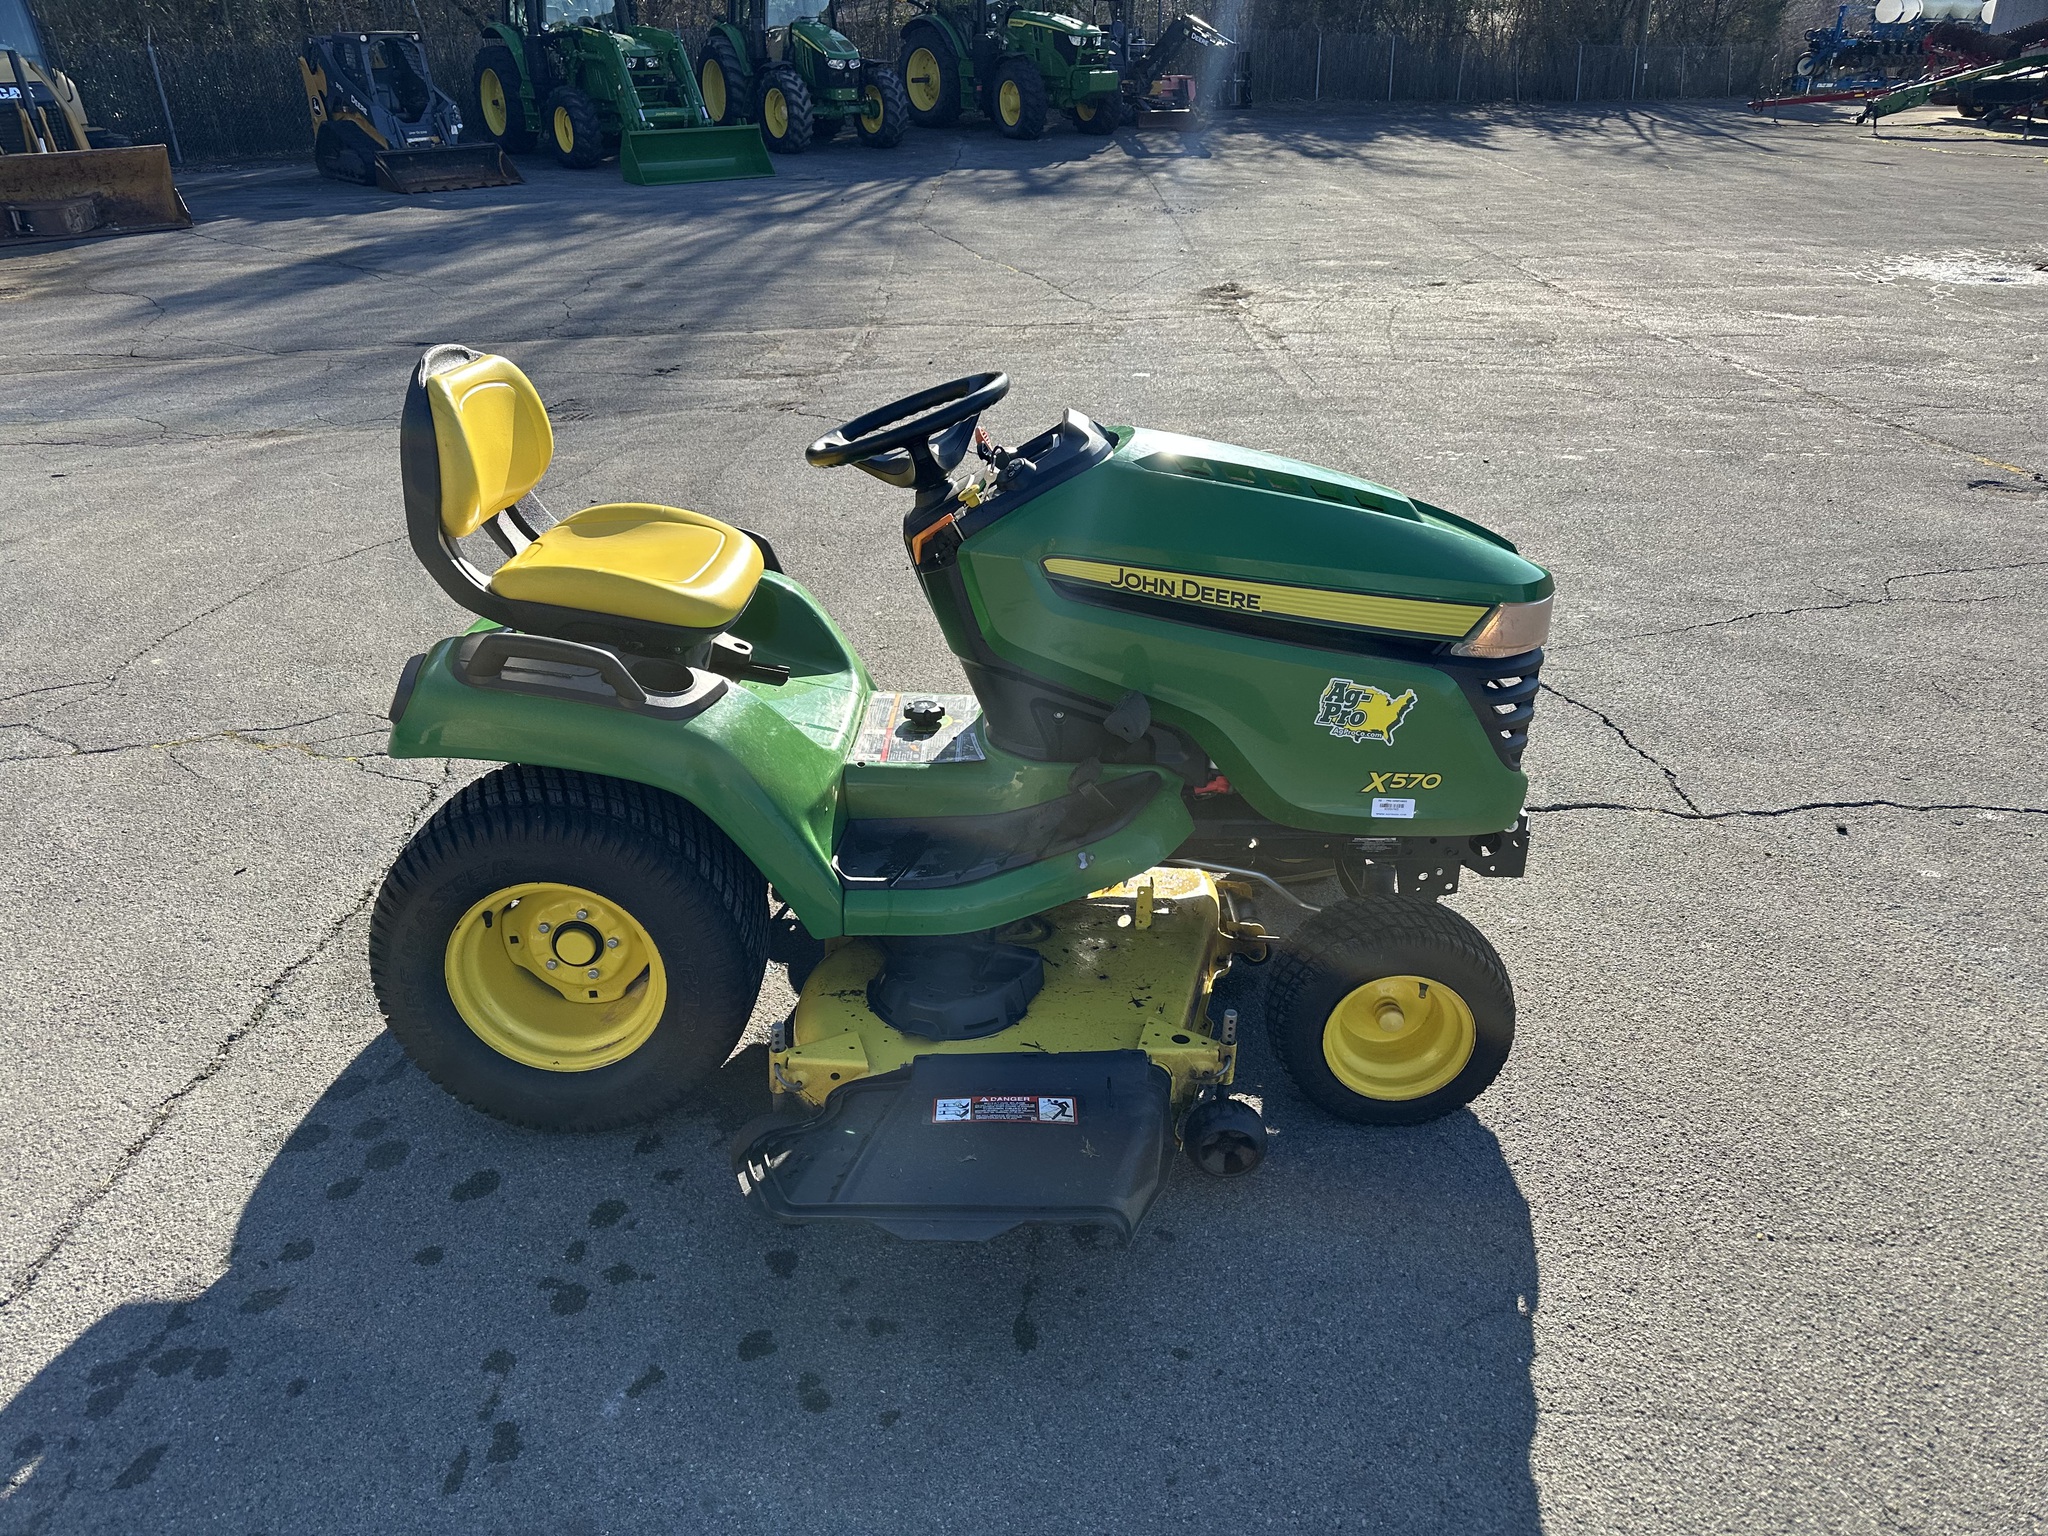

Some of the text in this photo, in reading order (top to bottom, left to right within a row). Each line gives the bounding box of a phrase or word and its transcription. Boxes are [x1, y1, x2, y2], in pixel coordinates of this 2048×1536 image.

[0, 87, 35, 99] CA
[1110, 567, 1263, 612] JOHN DEERE
[1323, 681, 1374, 709] Ag-
[1318, 702, 1367, 728] Pro
[1332, 727, 1383, 739] AgProCo.com
[1360, 771, 1443, 794] X570
